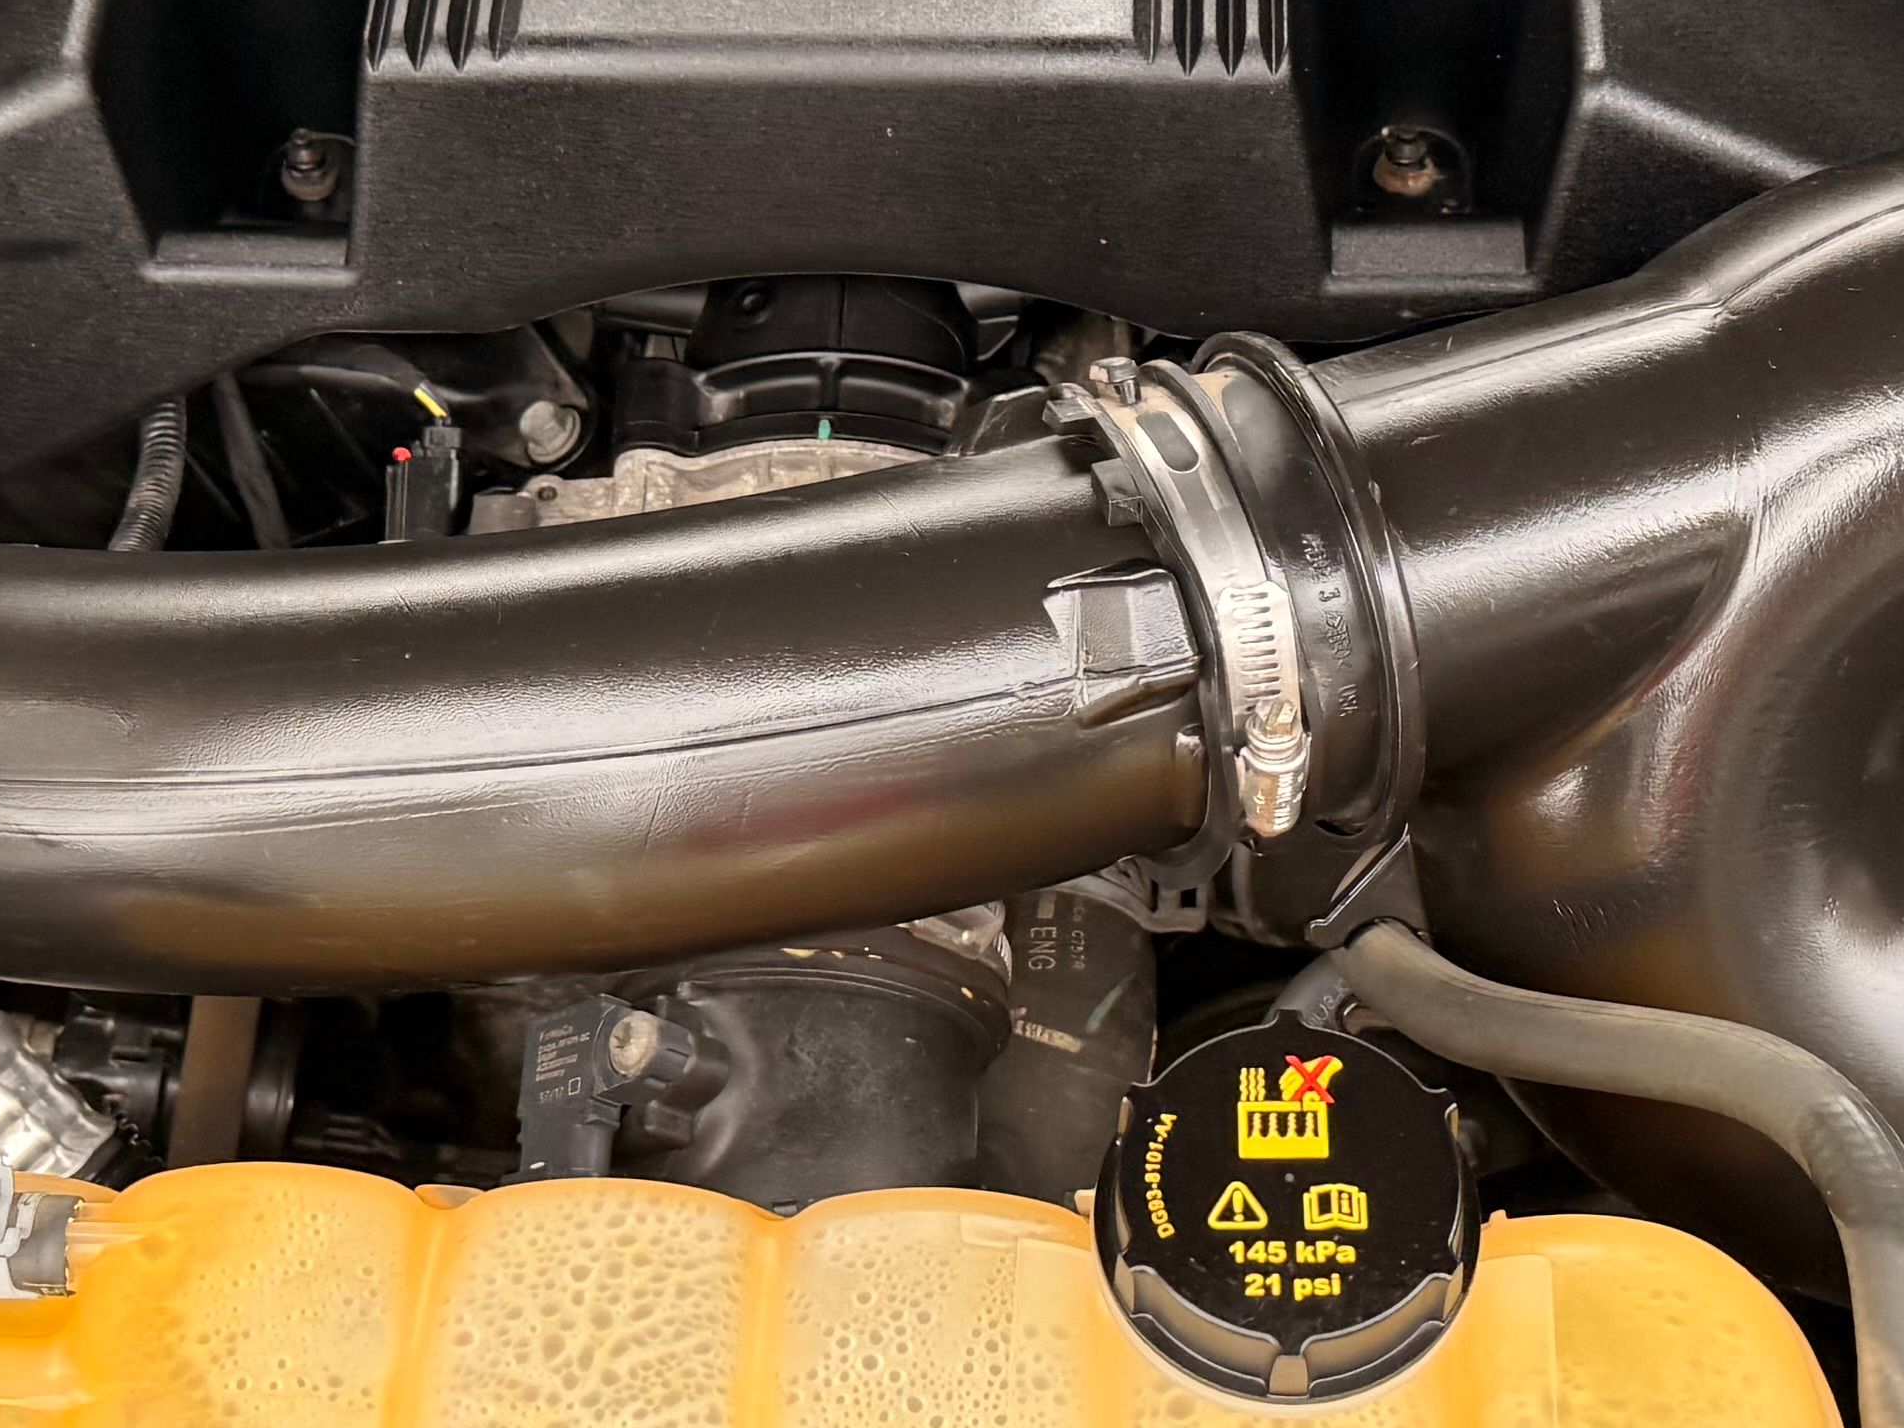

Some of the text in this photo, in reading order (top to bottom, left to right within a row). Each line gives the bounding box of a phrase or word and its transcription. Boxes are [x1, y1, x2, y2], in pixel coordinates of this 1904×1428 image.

[1028, 924, 1058, 972] ENG
[1228, 1240, 1357, 1265] 145 kPa
[1244, 1272, 1342, 1302] 21 psi
